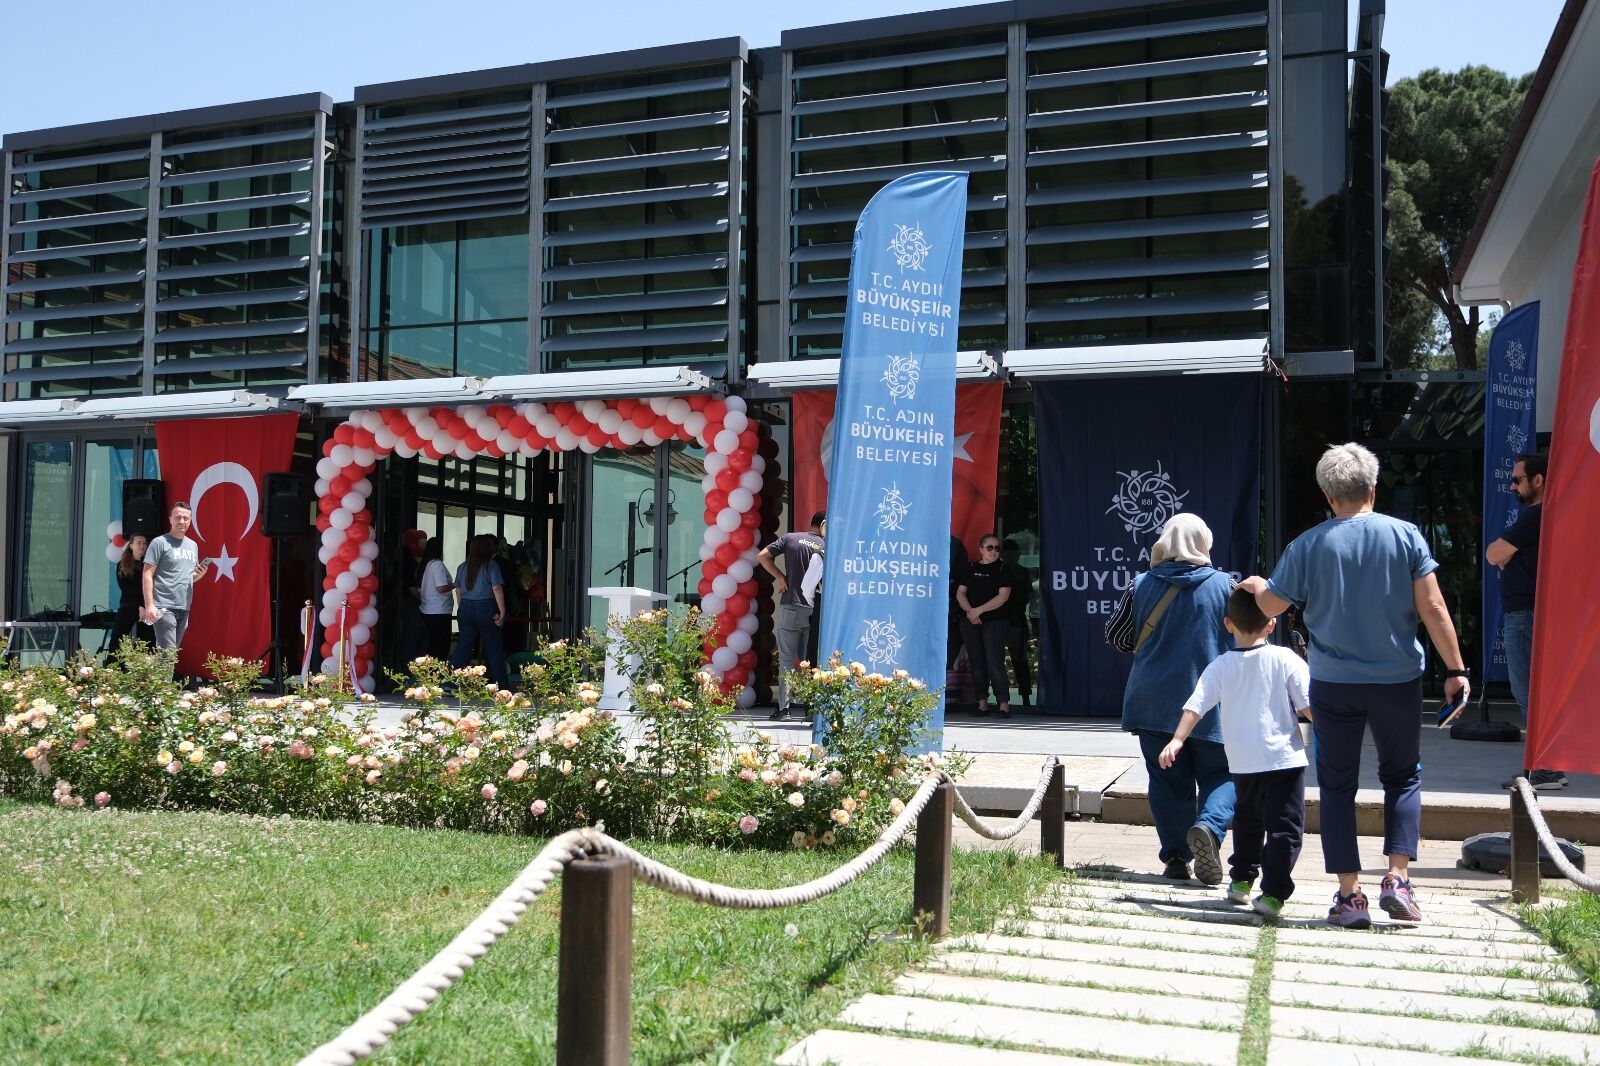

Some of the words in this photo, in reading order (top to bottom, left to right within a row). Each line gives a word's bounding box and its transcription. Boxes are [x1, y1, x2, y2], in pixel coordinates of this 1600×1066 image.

[871, 272, 897, 290] T.C.
[864, 405, 890, 422] T.C.
[879, 541, 928, 557] AYDIN
[1094, 547, 1131, 562] T.C.
[847, 579, 933, 598] BLEDİYESİ
